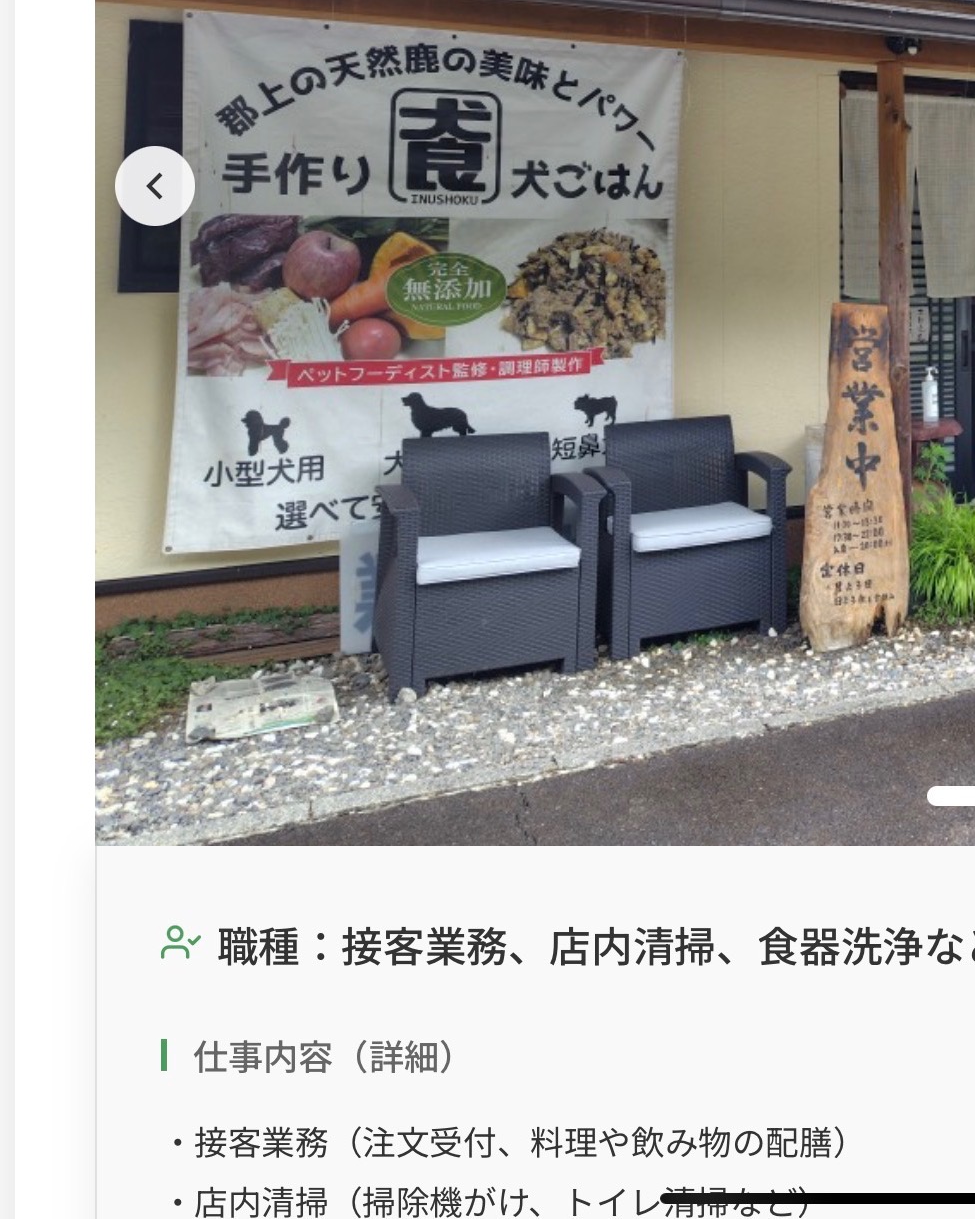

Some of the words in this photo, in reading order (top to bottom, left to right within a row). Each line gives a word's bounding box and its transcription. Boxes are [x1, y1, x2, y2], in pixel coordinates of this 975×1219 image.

[214, 43, 656, 152] 郡上の天然鹿の美味とパワー
[222, 152, 370, 196] 手作り
[511, 159, 664, 200] 犬ごはん
[410, 193, 479, 206] INUSHOKU
[427, 261, 470, 277] 完全
[402, 276, 492, 302] 無添加
[841, 324, 886, 492] 営業中
[551, 432, 606, 462] 短鼻
[203, 454, 325, 488] 小型犬用
[193, 1039, 452, 1074] 仕事内容（詳細）
